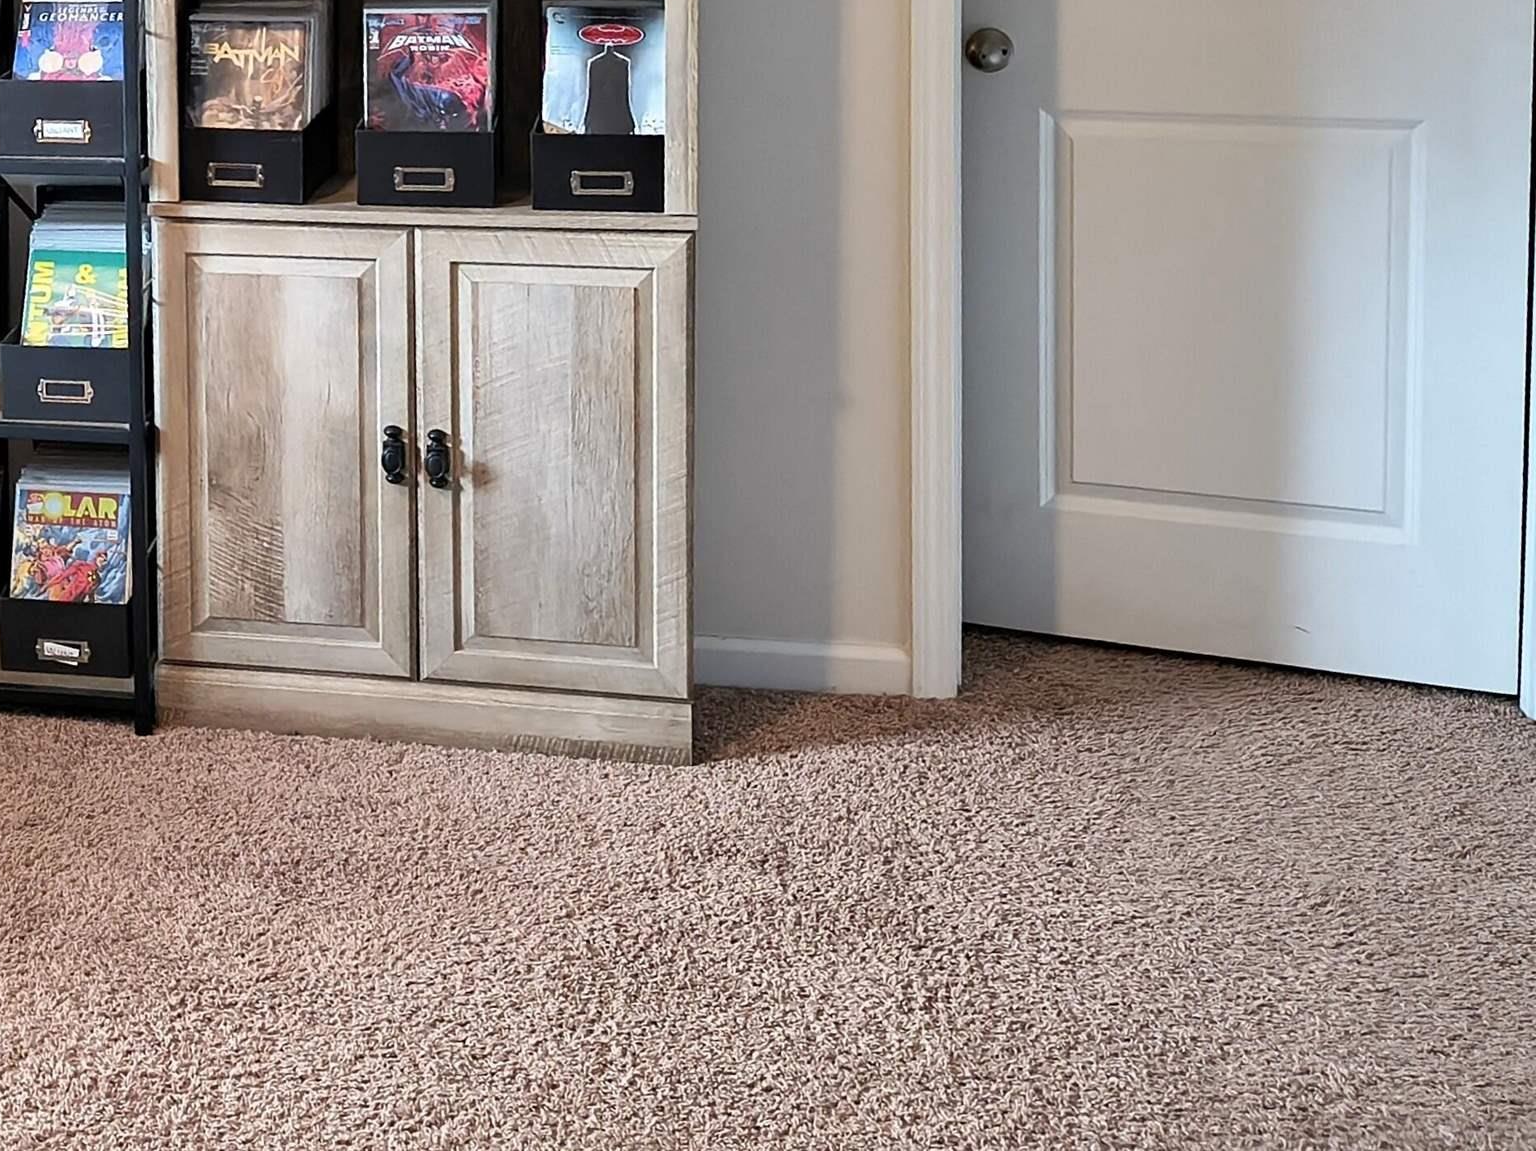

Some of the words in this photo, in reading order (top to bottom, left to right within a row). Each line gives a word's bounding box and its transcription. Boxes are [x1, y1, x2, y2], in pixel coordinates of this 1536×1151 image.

[38, 12, 124, 22] GEOMANCER
[387, 34, 474, 51] BATMAN
[409, 44, 450, 52] ROBIN
[203, 28, 300, 79] BATMAN
[73, 263, 97, 285] &
